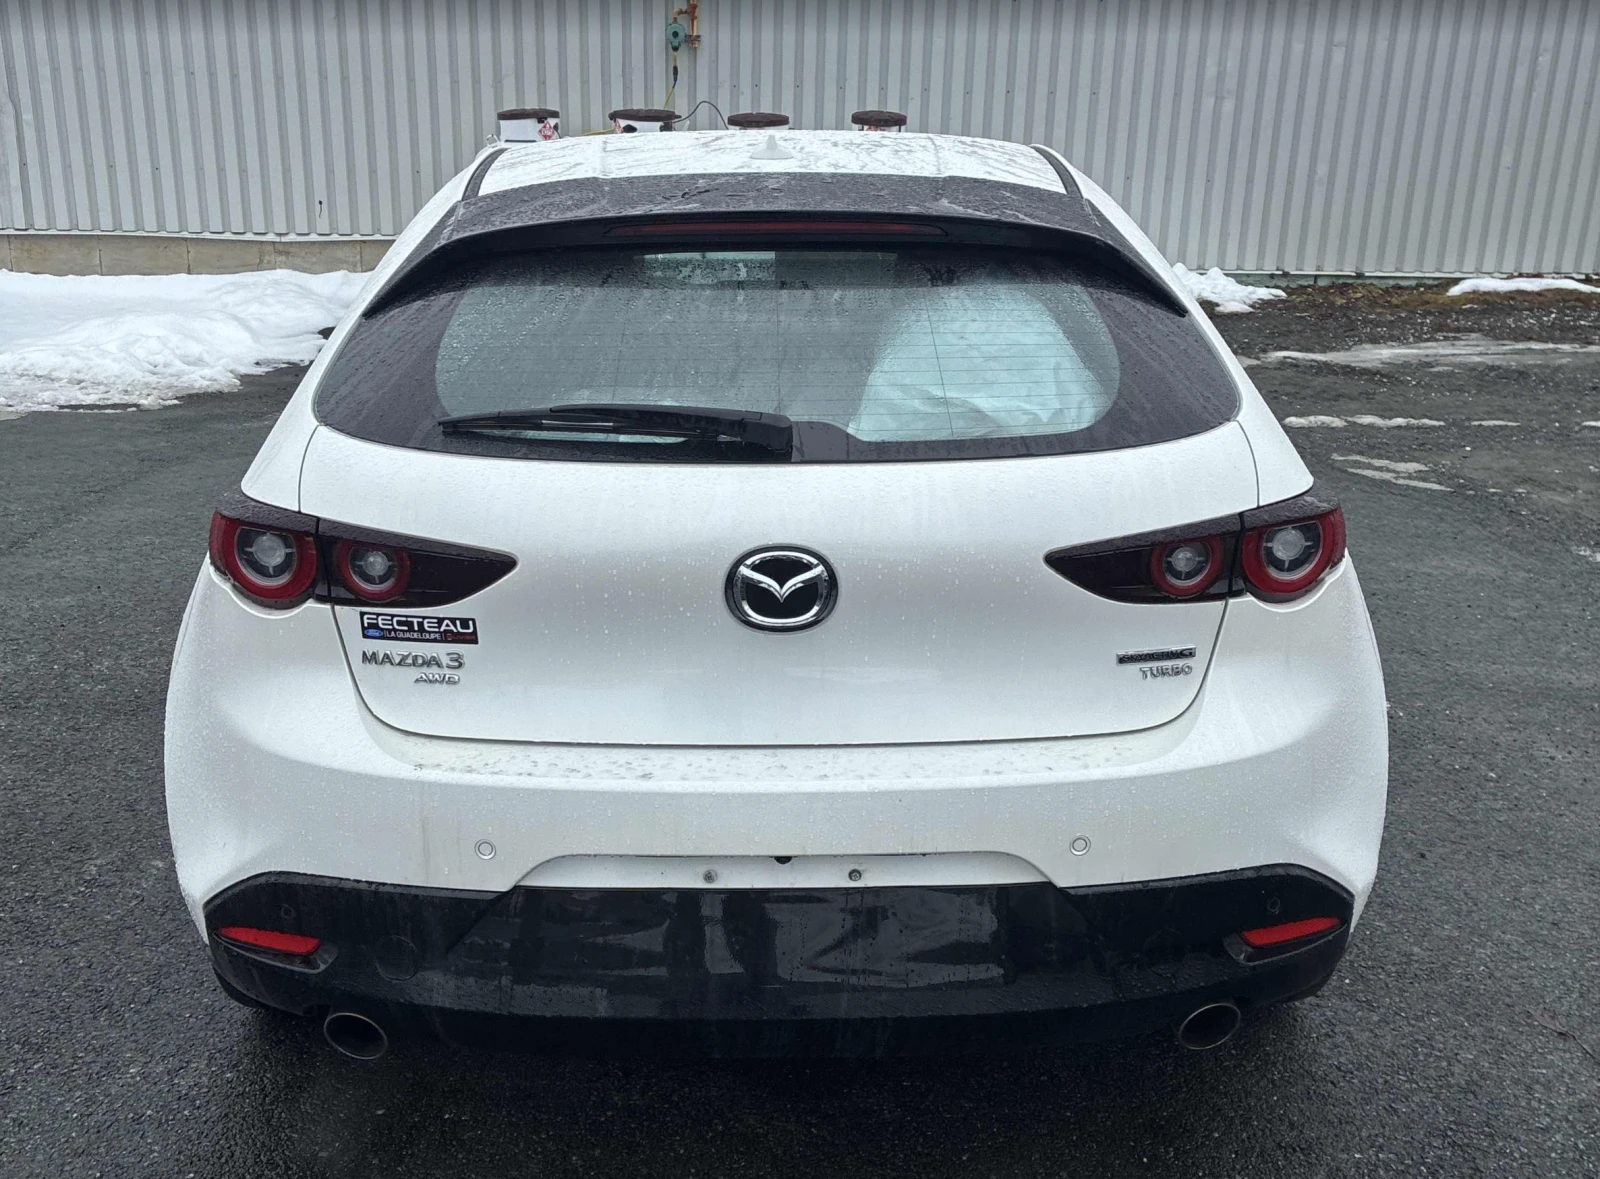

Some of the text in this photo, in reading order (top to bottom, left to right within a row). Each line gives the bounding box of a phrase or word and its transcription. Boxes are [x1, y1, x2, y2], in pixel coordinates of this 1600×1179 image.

[363, 614, 474, 633] FECTEAU
[386, 630, 442, 640] LA GUADELOUPE
[1139, 663, 1192, 679] TURBO
[414, 672, 460, 685] AWD
